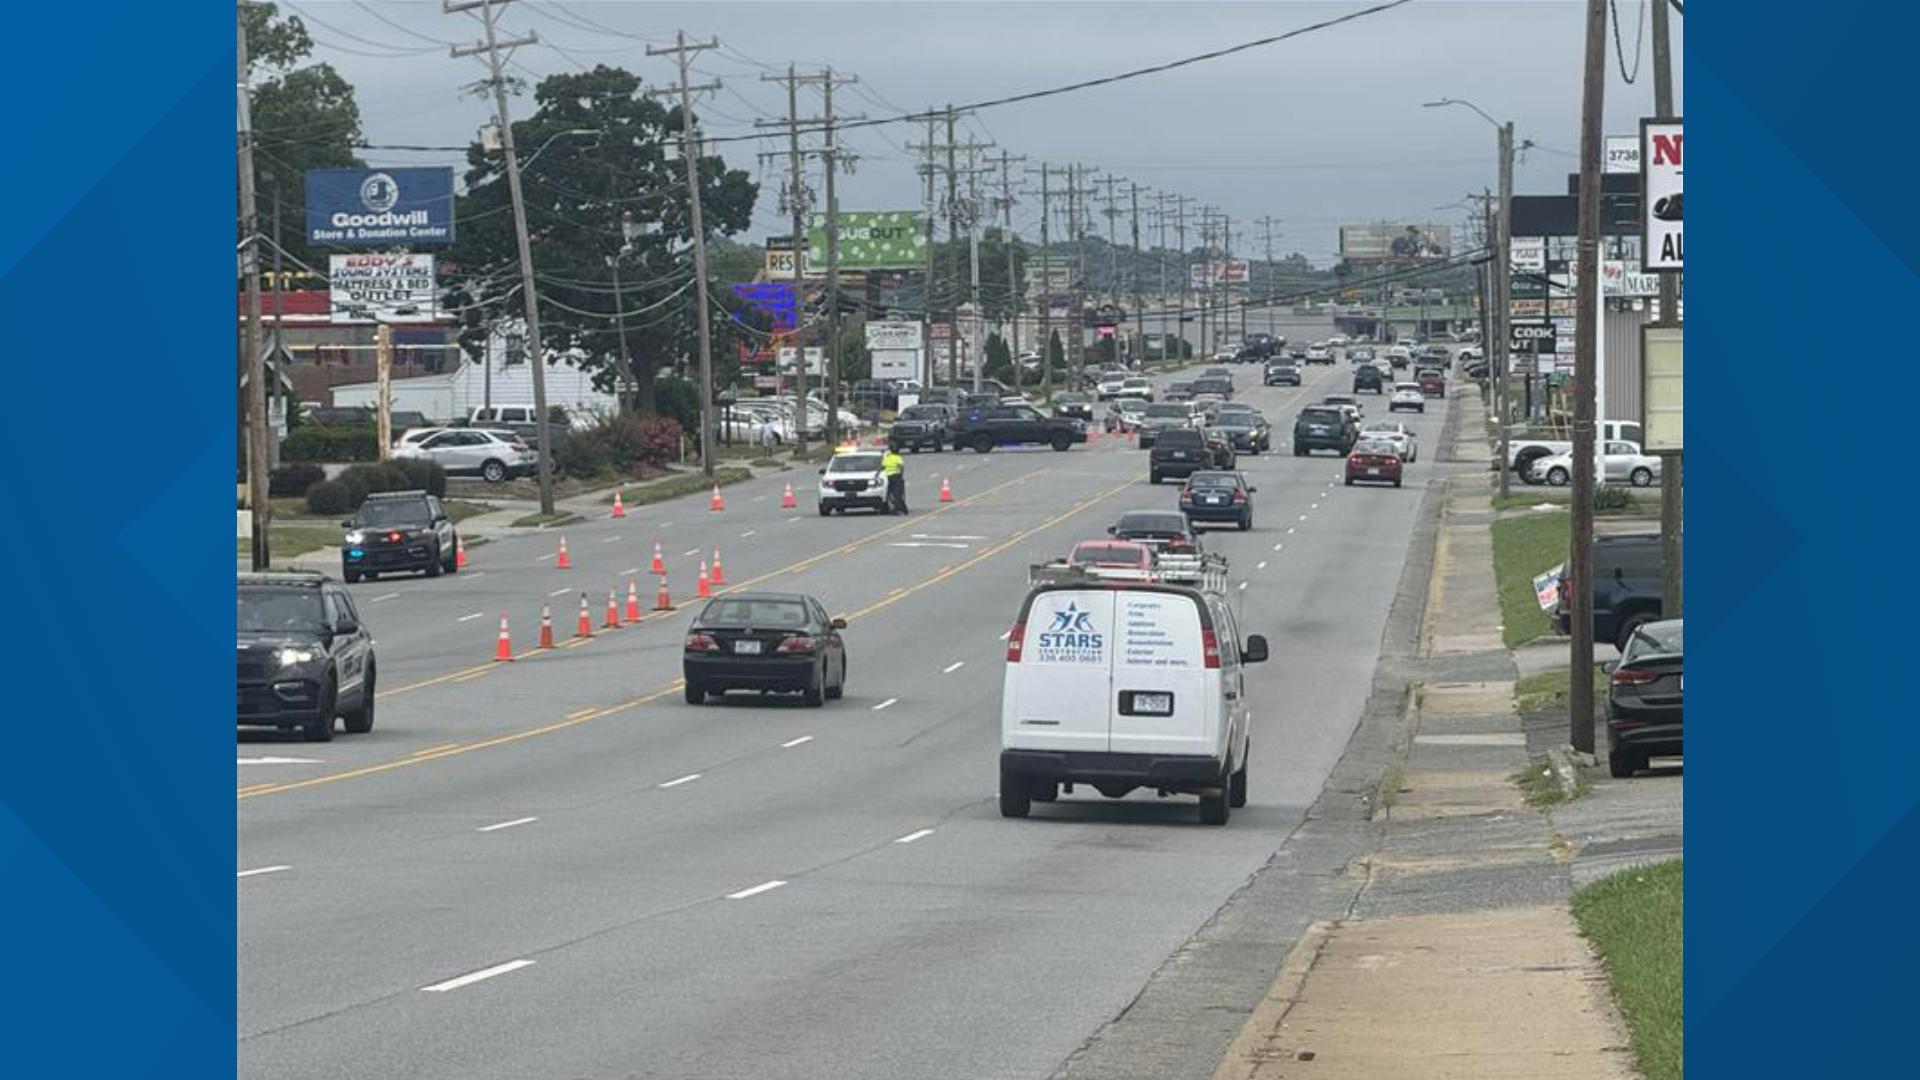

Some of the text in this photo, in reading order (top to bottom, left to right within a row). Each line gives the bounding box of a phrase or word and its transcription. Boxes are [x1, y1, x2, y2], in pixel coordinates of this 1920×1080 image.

[1608, 148, 1639, 161] 3738
[331, 210, 429, 227] Goodwill
[313, 226, 447, 240] Store & Donation Center
[345, 255, 414, 267] EDDY'S
[333, 265, 429, 278] SOUND SYSTEMS
[332, 279, 430, 290] MATTRESS & BED
[349, 290, 414, 301] OUTLET
[1513, 326, 1554, 338] COOK
[1510, 338, 1530, 350] UT
[1039, 633, 1103, 648] STARS
